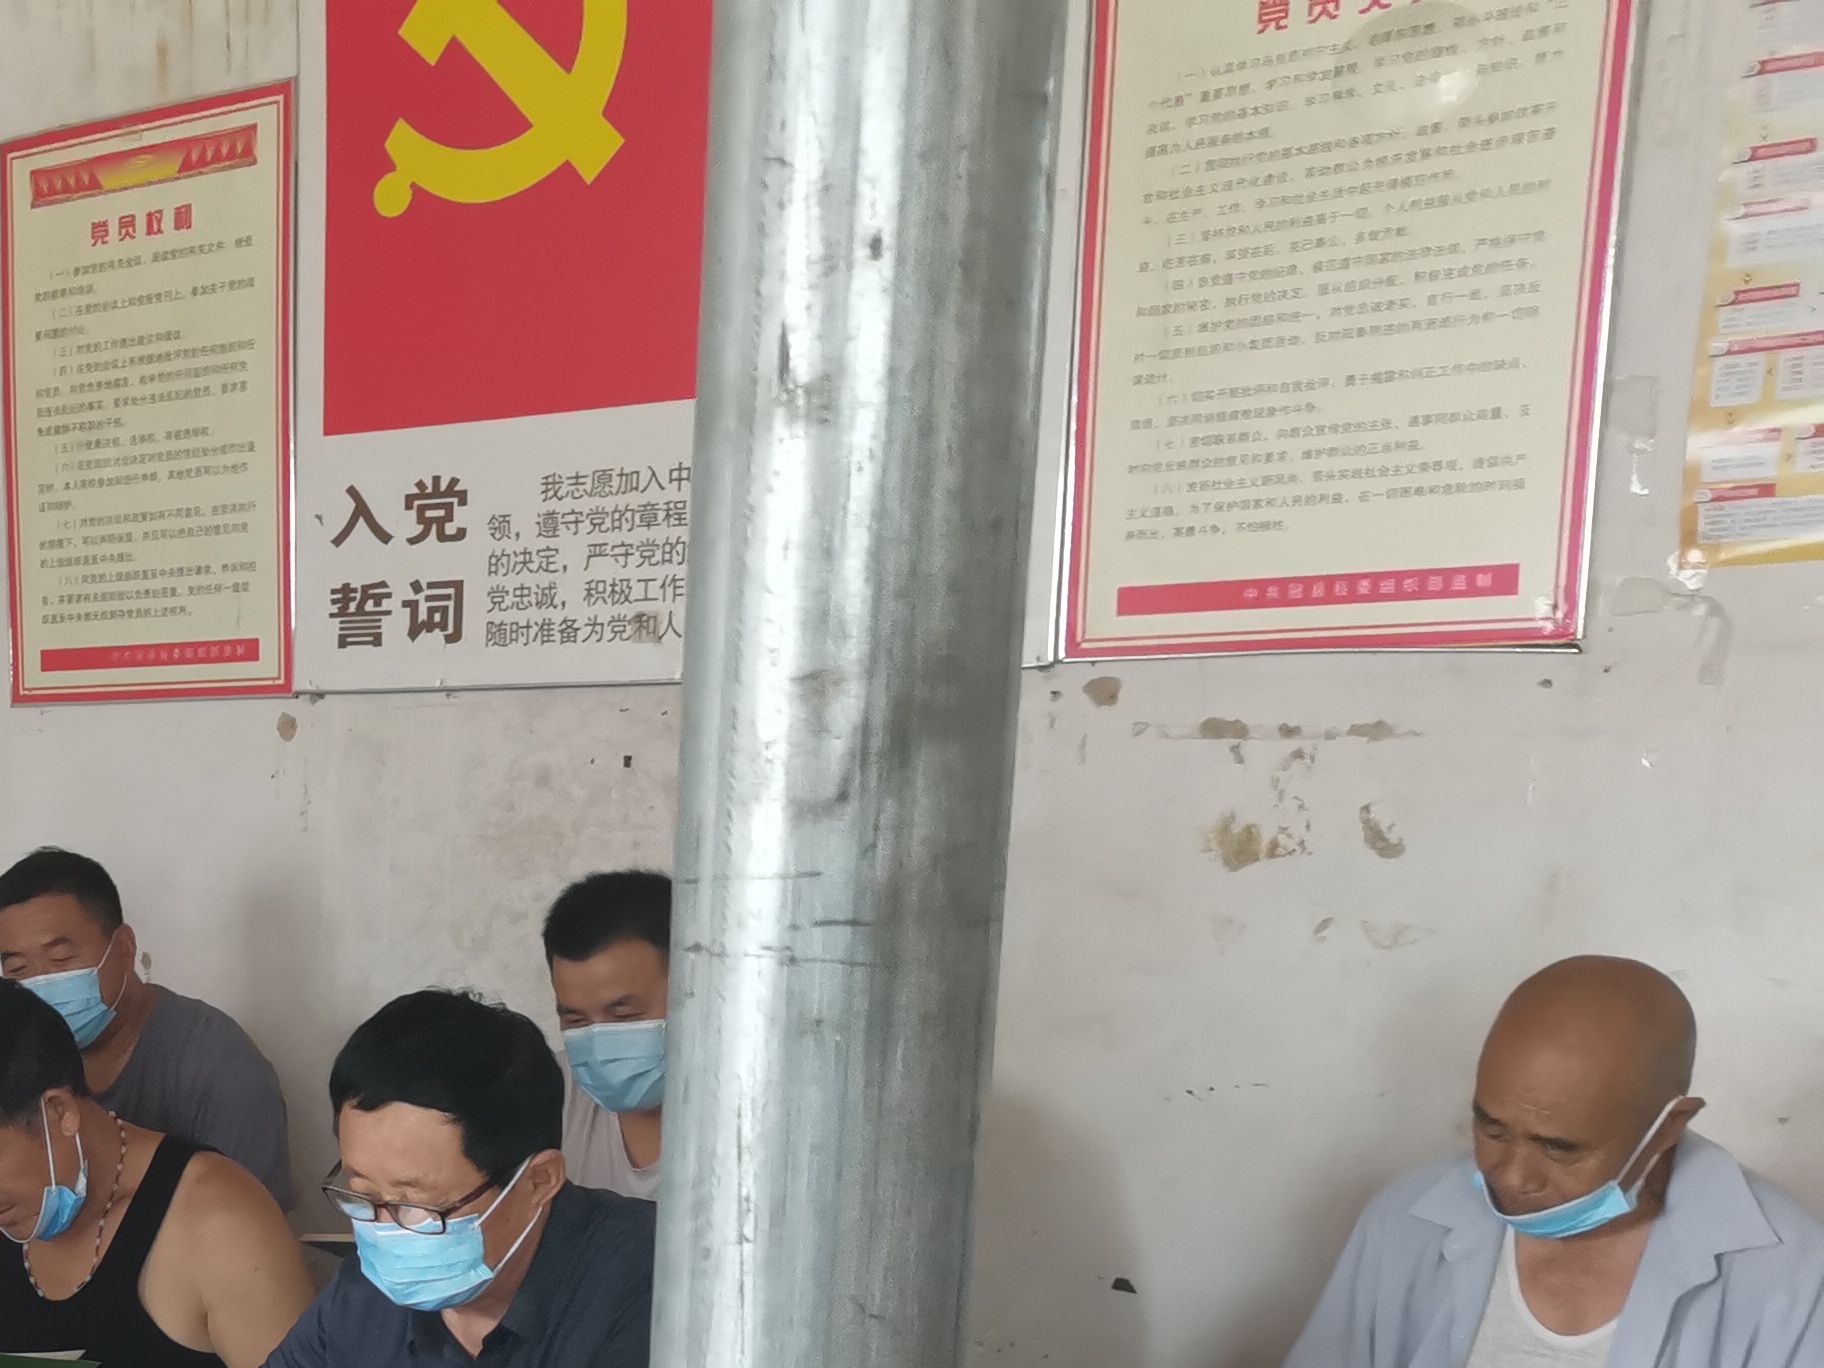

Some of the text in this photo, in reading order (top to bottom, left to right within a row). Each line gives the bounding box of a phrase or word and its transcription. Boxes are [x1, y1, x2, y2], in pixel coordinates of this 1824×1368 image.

[90, 203, 193, 247] 党员权利
[540, 461, 692, 502] 我志愿加入中
[329, 475, 468, 549] 入党
[328, 579, 465, 650] 誓词
[485, 610, 683, 648] 随时准备为党和人
